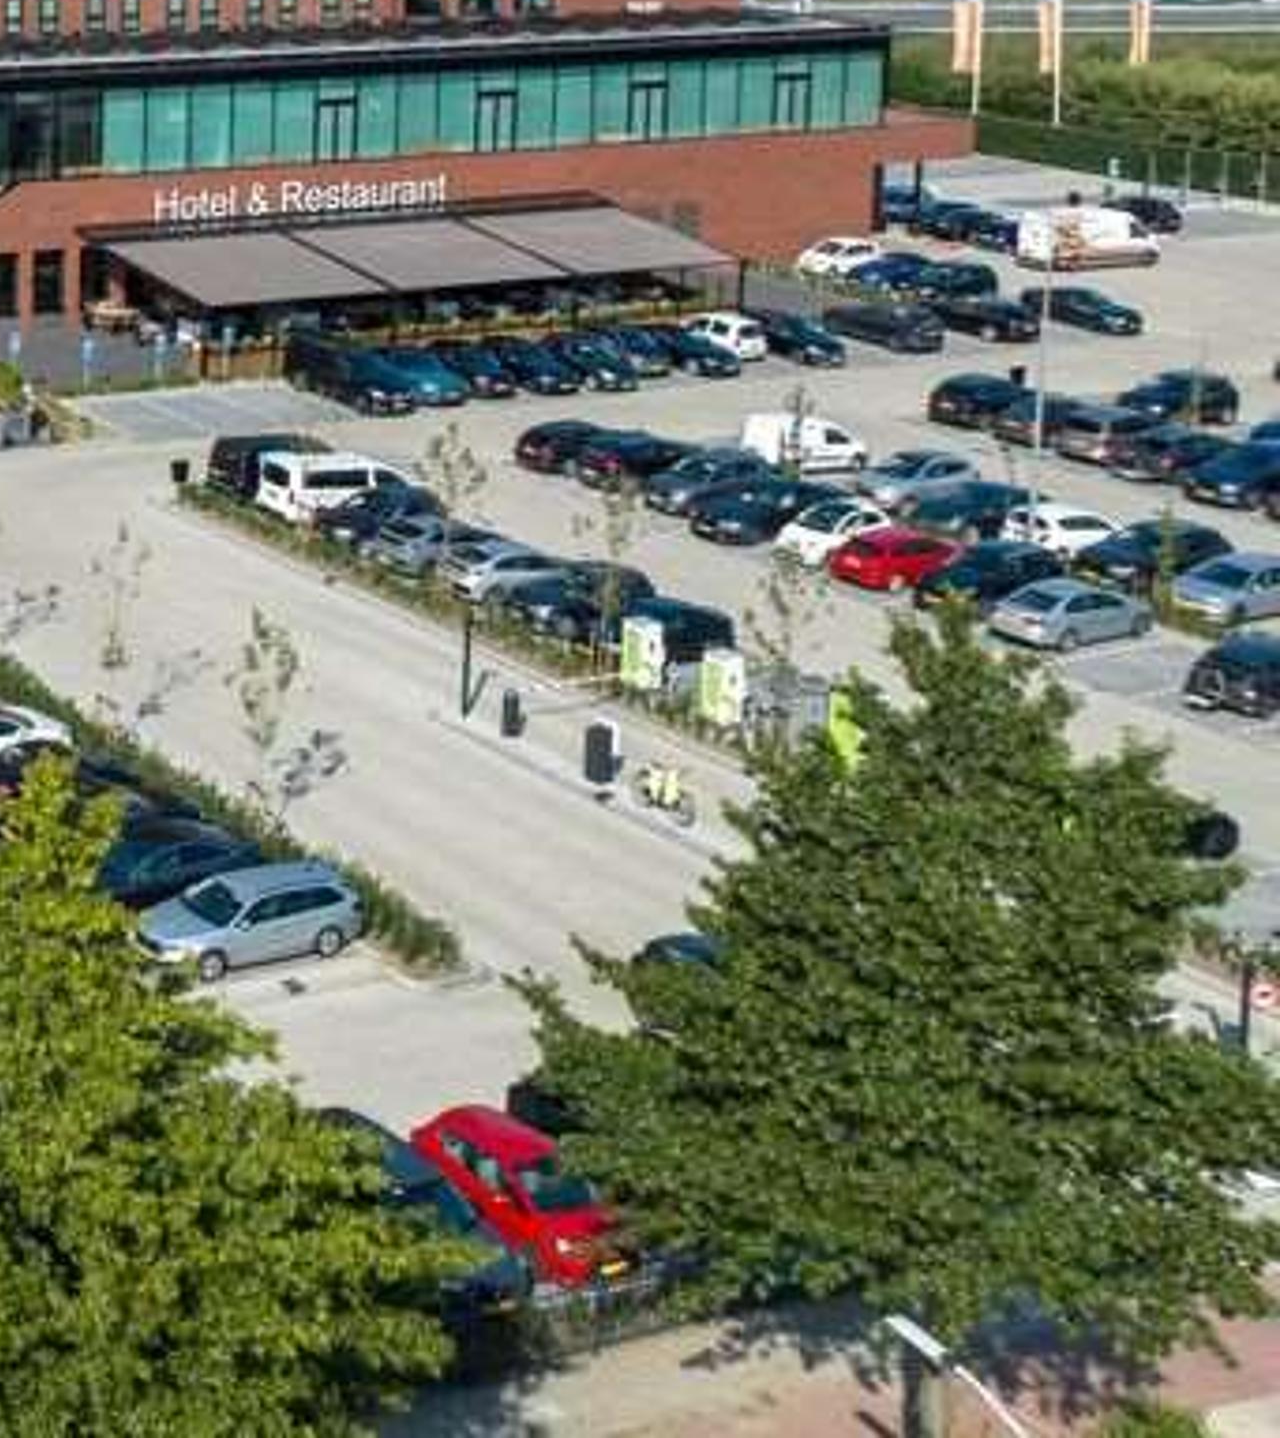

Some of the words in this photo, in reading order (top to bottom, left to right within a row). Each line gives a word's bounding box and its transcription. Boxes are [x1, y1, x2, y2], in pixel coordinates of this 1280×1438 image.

[153, 184, 237, 221] Hotel
[247, 181, 270, 216] &
[281, 172, 446, 213] Restaurant
